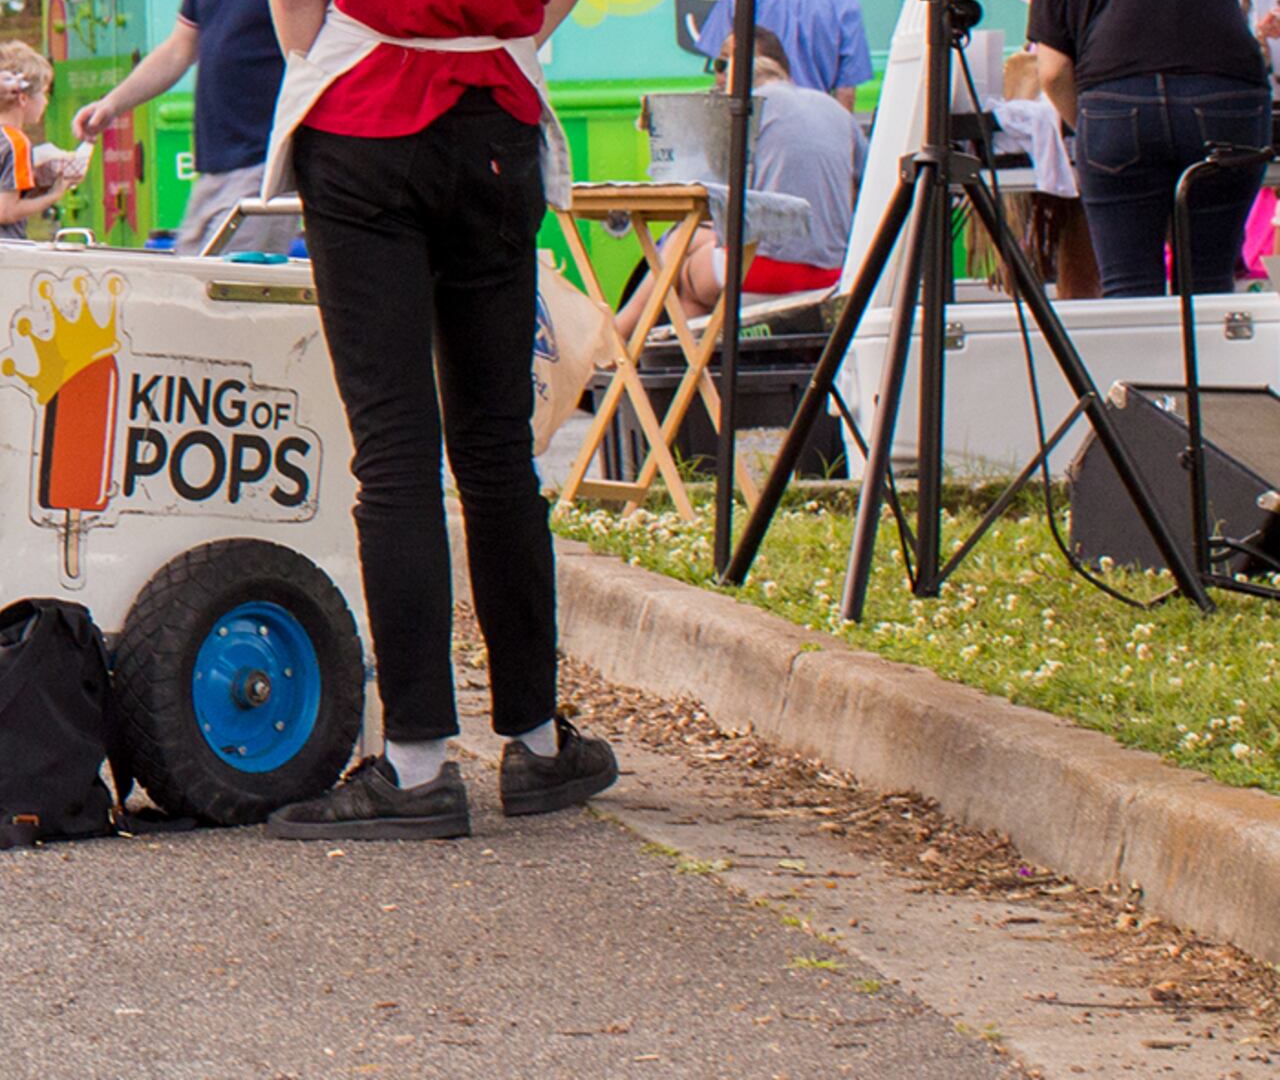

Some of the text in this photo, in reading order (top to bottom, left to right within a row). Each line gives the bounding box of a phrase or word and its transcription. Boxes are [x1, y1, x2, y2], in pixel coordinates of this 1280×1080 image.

[128, 372, 292, 431] KING OF
[123, 425, 311, 507] POPS
